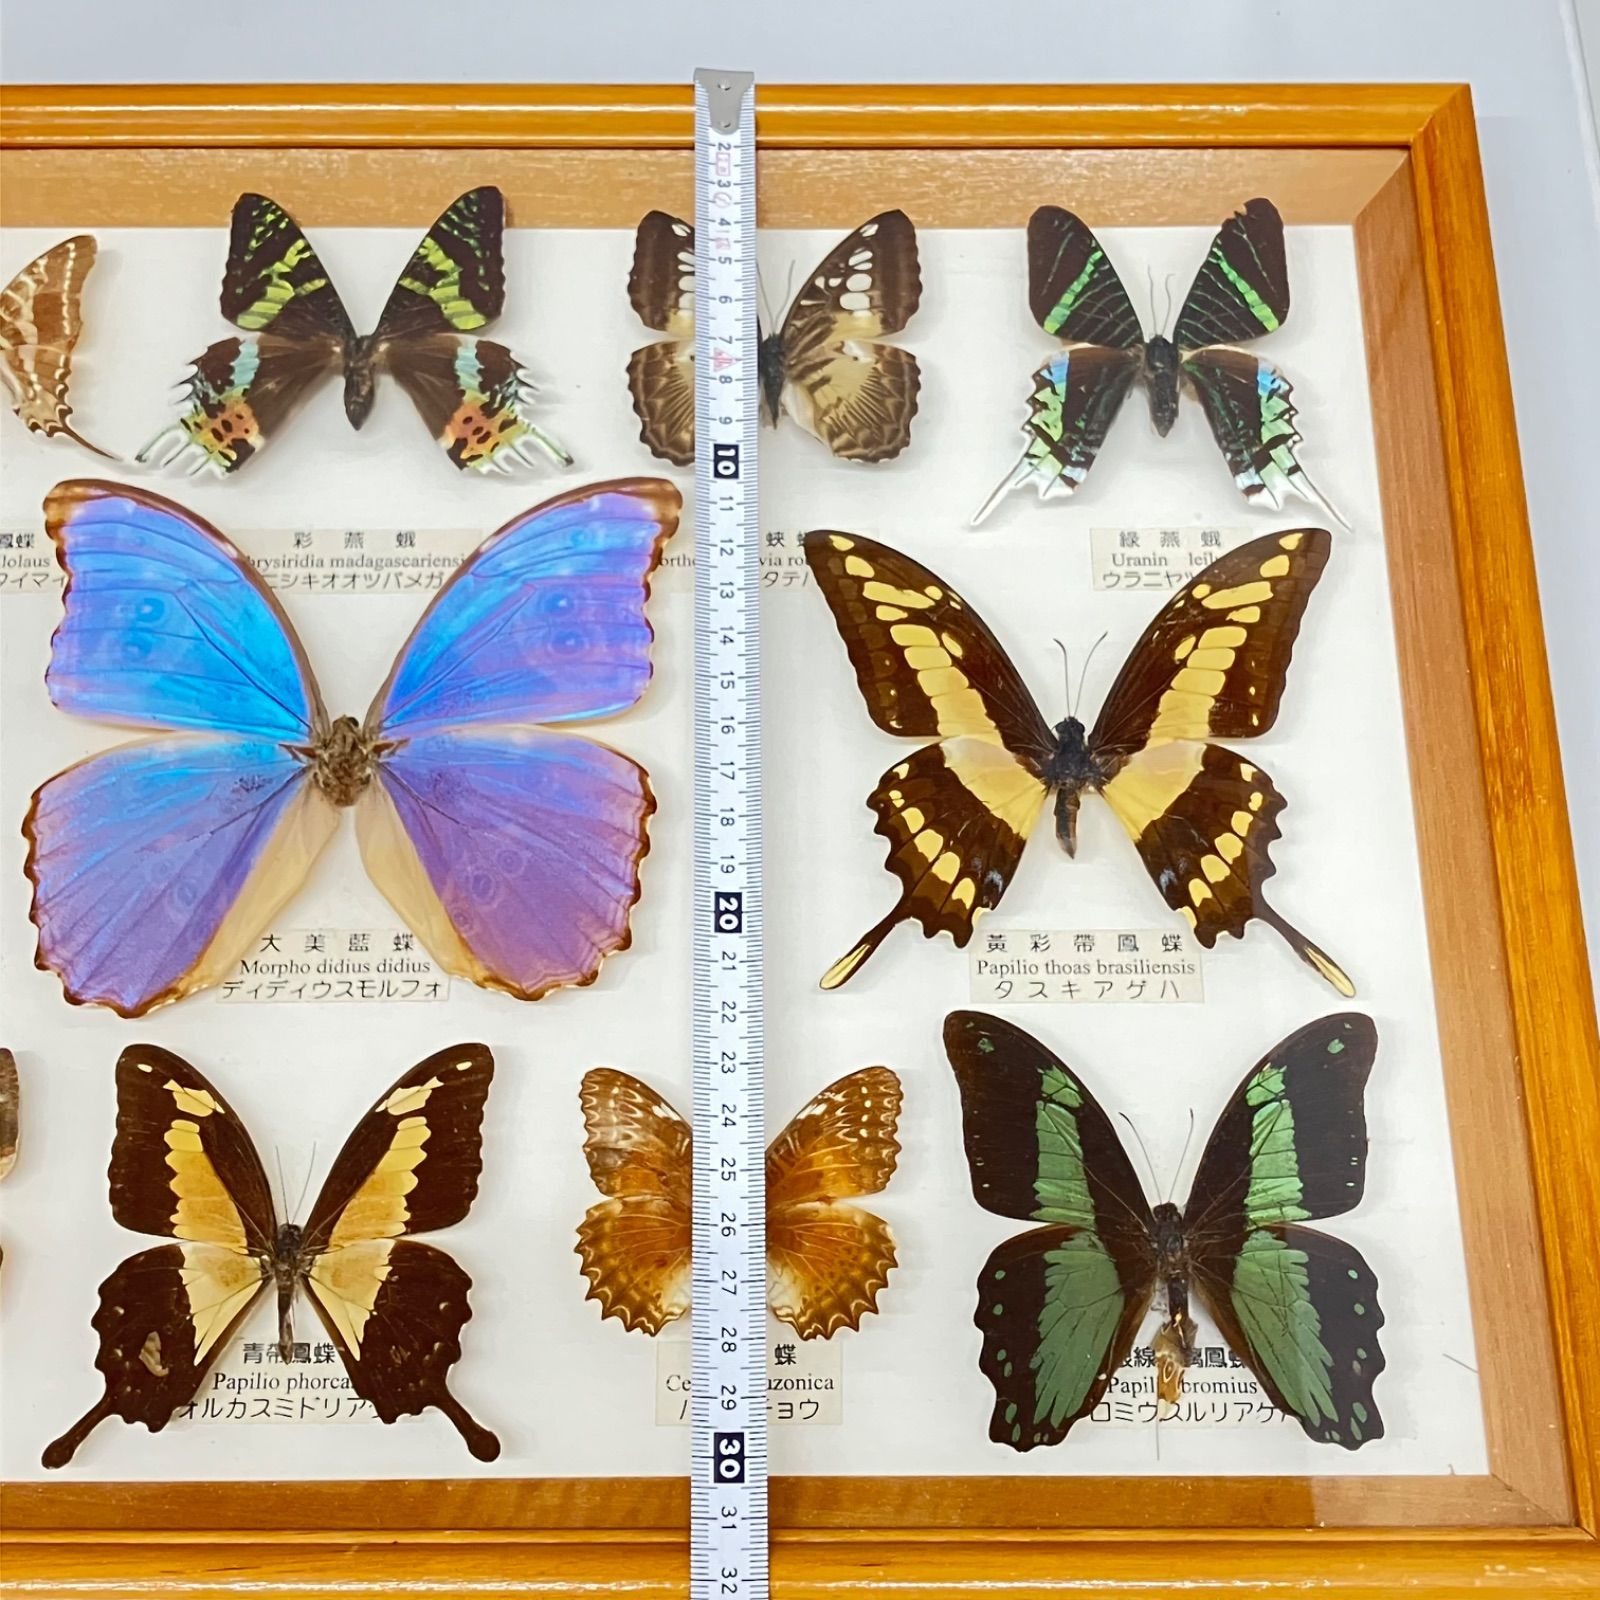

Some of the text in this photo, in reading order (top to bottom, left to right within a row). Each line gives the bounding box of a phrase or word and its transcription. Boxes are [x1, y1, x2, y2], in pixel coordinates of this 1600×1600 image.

[718, 142, 732, 152] 2
[717, 179, 732, 189] 3
[719, 217, 732, 228] 4
[718, 256, 733, 266] 5
[719, 295, 733, 305] 6
[719, 335, 733, 346] 7
[719, 374, 733, 386] 8
[719, 416, 733, 426] 9
[717, 448, 736, 476] 10
[720, 496, 734, 515] 11
[720, 539, 735, 557] 12
[720, 582, 735, 600] 13
[720, 626, 735, 646] 14
[721, 671, 736, 690] 15
[721, 716, 736, 735] 16
[720, 762, 736, 781] 17
[720, 808, 736, 827] 18
[720, 855, 736, 874] 19
[719, 897, 739, 931] 20
[240, 959, 430, 977] Morpho didius didius
[722, 951, 737, 971] 21
[977, 960, 1195, 978] Papilio thoas brasiliensis
[722, 1001, 737, 1024] 22
[721, 1051, 737, 1074] 23
[721, 1104, 737, 1128] 24
[721, 1158, 737, 1182] 25
[721, 1212, 737, 1238] 26
[722, 1270, 738, 1296] 27
[721, 1327, 738, 1354] 28
[212, 1372, 280, 1394] Papilio
[721, 1385, 738, 1411] 29
[719, 1437, 742, 1480] 30
[721, 1506, 738, 1530] 31
[721, 1567, 738, 1595] 32
